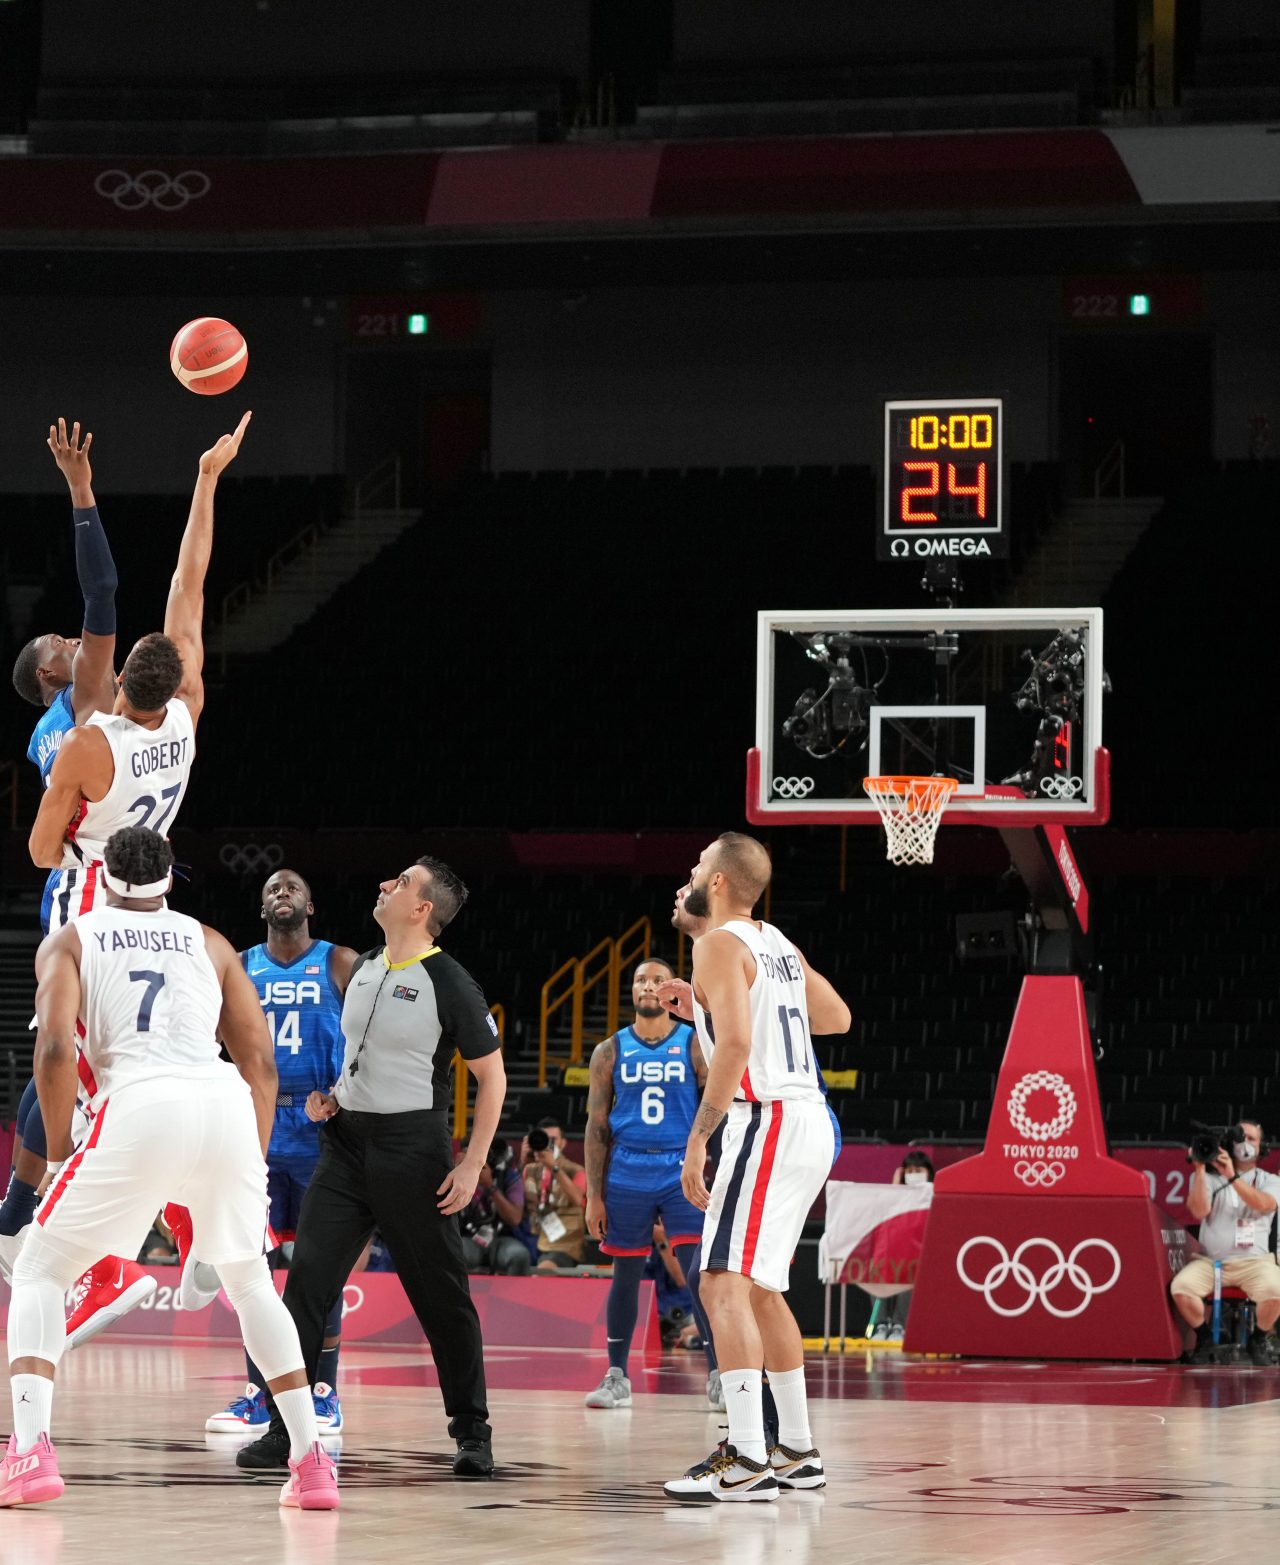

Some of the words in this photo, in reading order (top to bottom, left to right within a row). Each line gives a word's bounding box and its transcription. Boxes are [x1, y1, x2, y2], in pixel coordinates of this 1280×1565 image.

[1071, 294, 1118, 317] 222
[909, 414, 993, 450] 10:00
[901, 461, 987, 523] 24
[914, 537, 992, 557] OMEGA
[131, 737, 188, 779] GOBERT
[127, 781, 182, 834] 27
[93, 928, 194, 957] YABUSELE
[128, 969, 166, 1033] 7
[254, 980, 321, 1007] USA
[265, 1010, 303, 1056] 14
[620, 1061, 686, 1084] USA
[641, 1086, 666, 1126] 6
[1002, 1143, 1045, 1159] TOKYO
[1047, 1145, 1080, 1160] 2020
